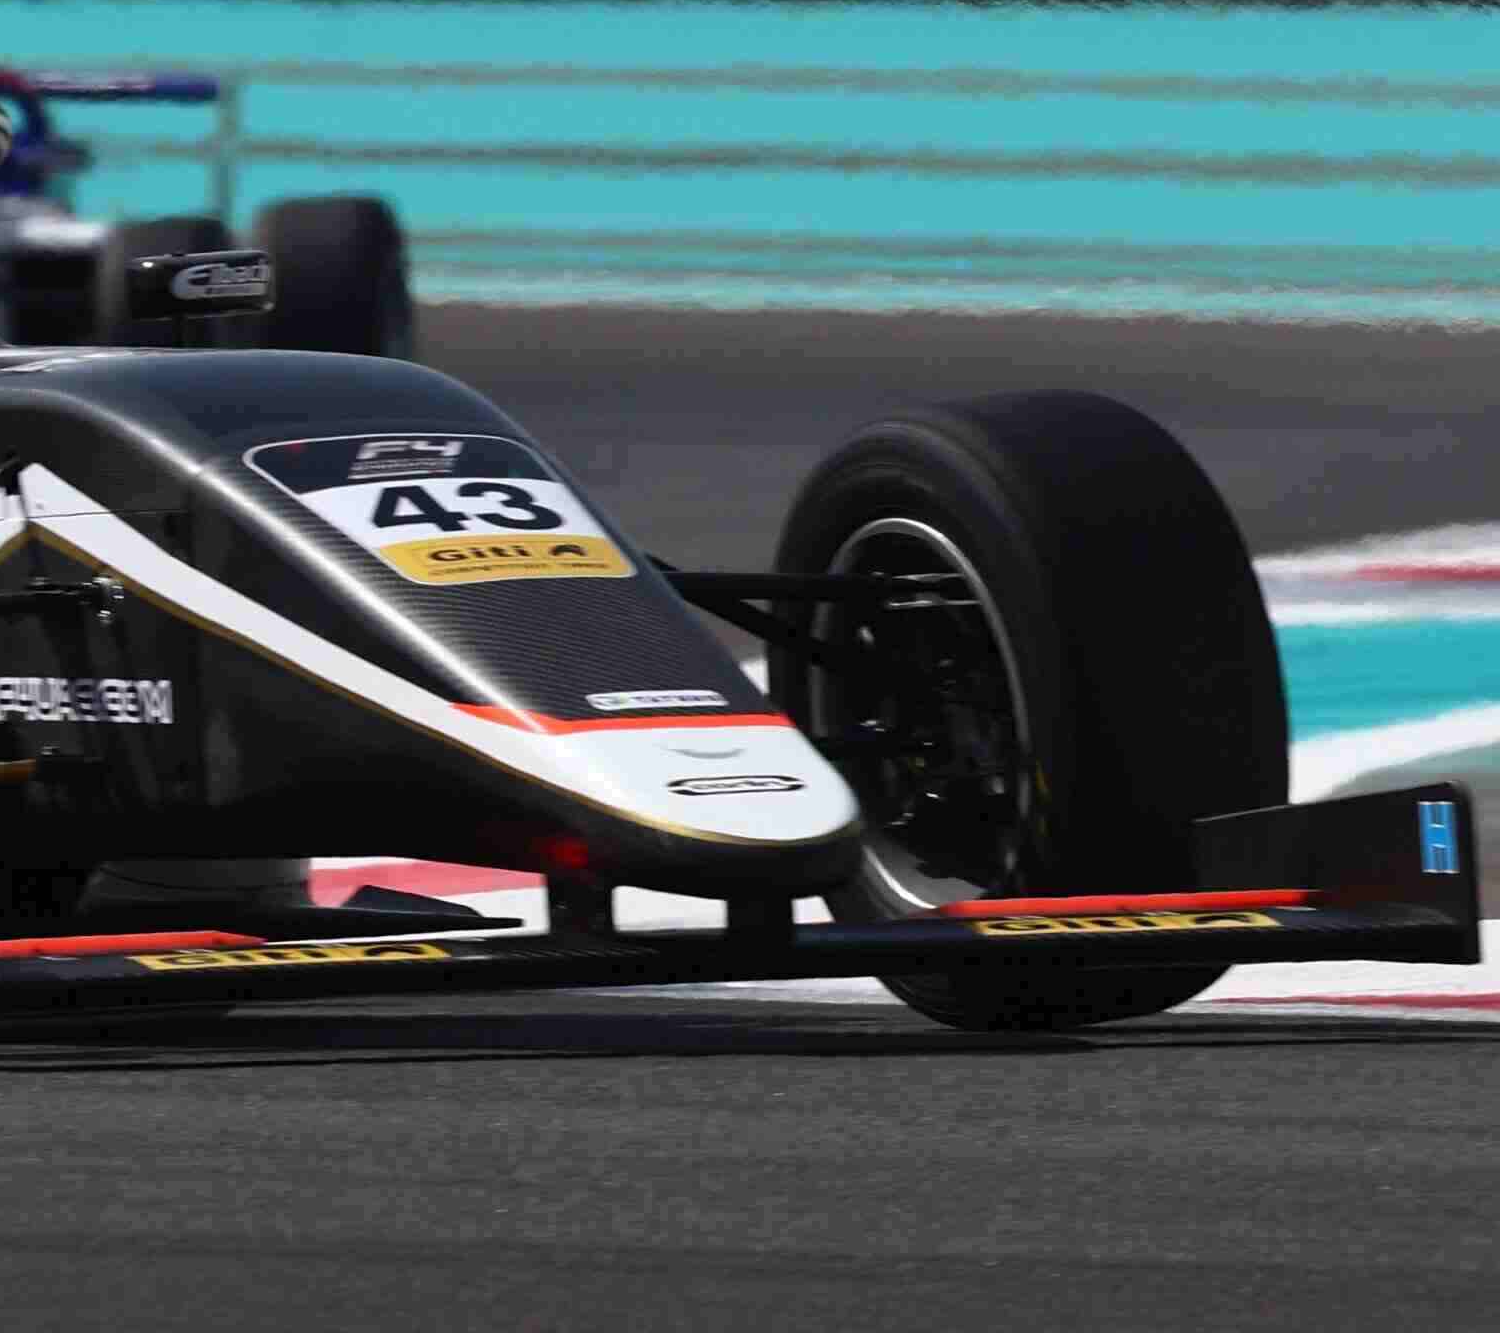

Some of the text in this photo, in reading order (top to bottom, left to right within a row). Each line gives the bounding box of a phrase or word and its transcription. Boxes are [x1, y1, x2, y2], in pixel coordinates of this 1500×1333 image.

[356, 440, 464, 460] F4
[372, 481, 564, 533] 43
[428, 544, 529, 563] Giti
